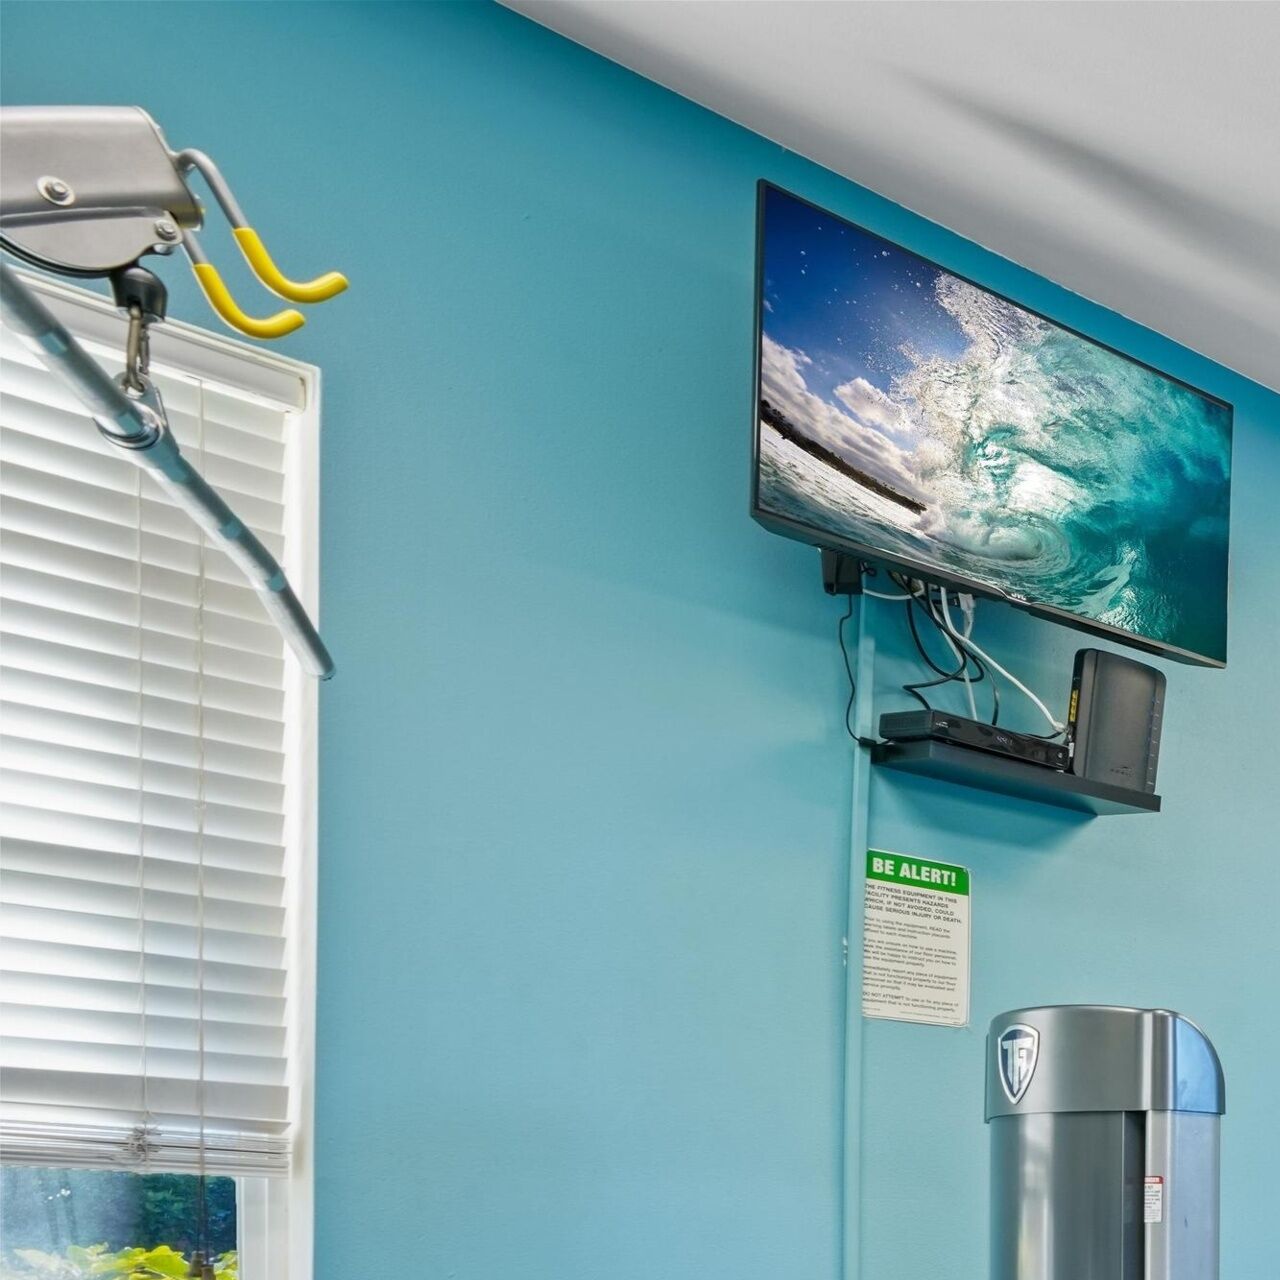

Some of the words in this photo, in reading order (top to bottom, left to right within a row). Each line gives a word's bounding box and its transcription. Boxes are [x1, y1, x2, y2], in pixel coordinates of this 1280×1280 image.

[872, 857, 895, 876] BE
[899, 862, 957, 887] ALERT!
[903, 890, 935, 899] EQUIPMENT
[891, 895, 920, 903] PRESENTS
[923, 900, 948, 908] HAZARDS
[886, 907, 910, 915] SERIOUS
[912, 911, 931, 919] INJURY
